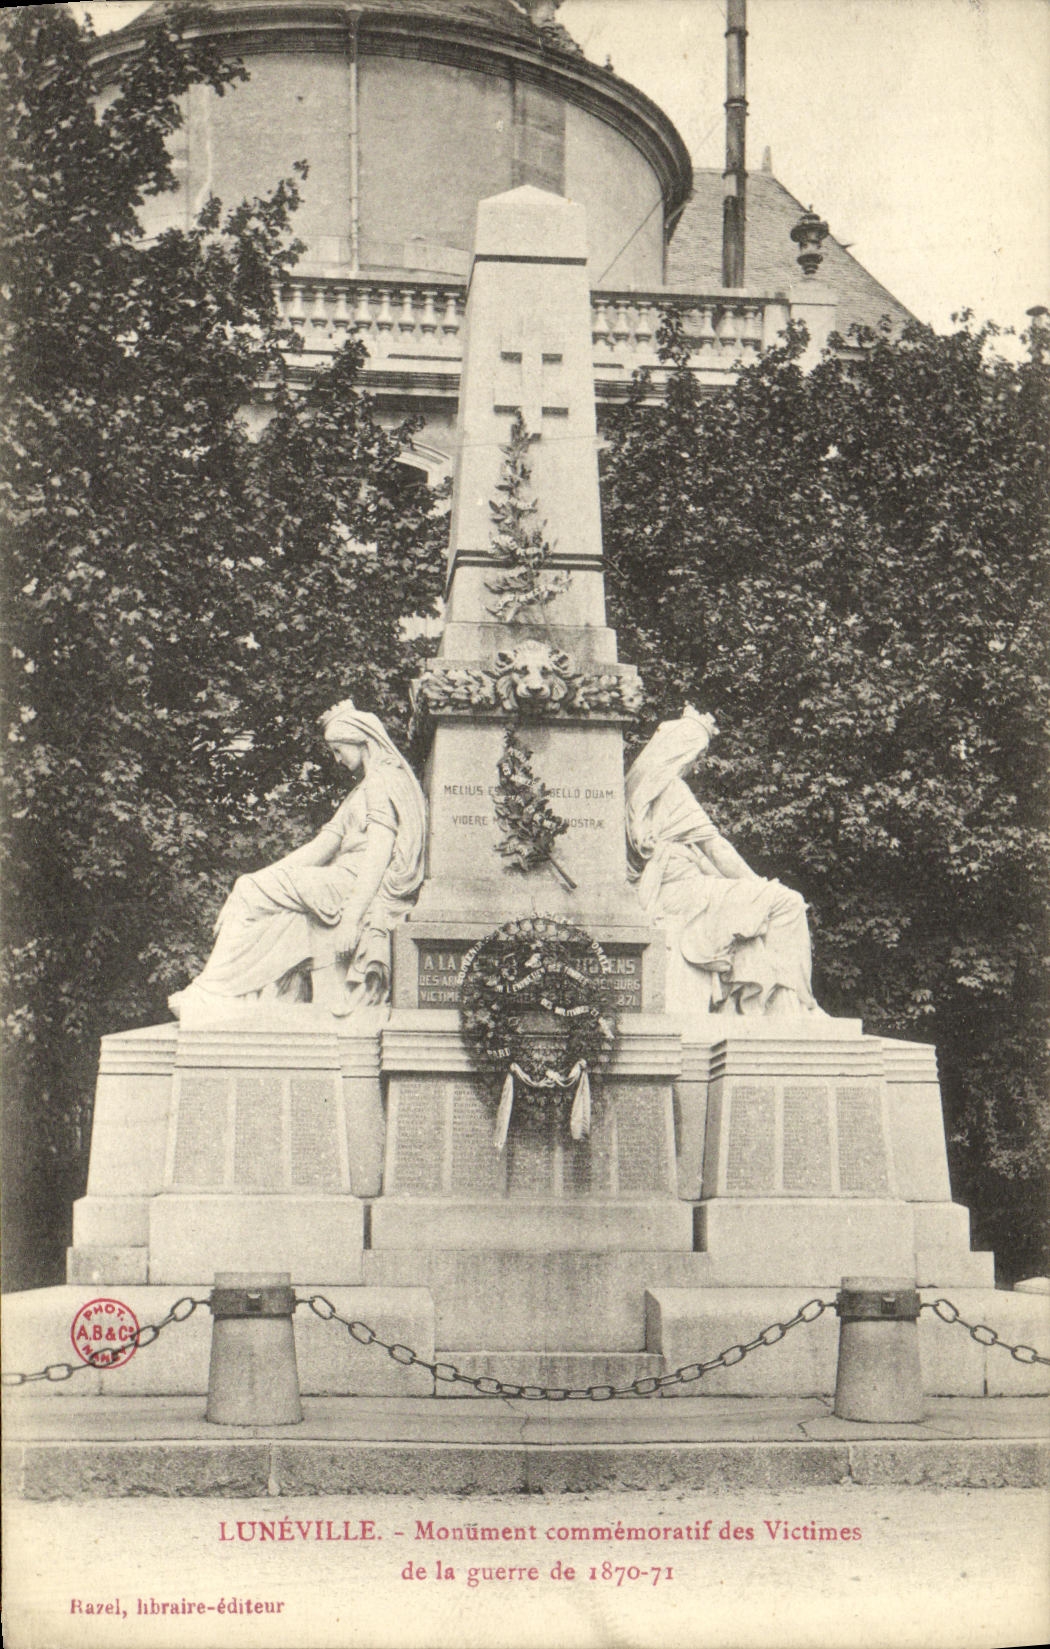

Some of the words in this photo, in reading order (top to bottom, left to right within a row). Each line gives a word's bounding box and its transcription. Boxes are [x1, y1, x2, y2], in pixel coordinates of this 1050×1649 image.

[444, 784, 484, 796] MELIUS
[549, 787, 580, 799] BELLO
[452, 815, 488, 826] VIDERE
[423, 955, 435, 971] A
[438, 954, 456, 971] LA
